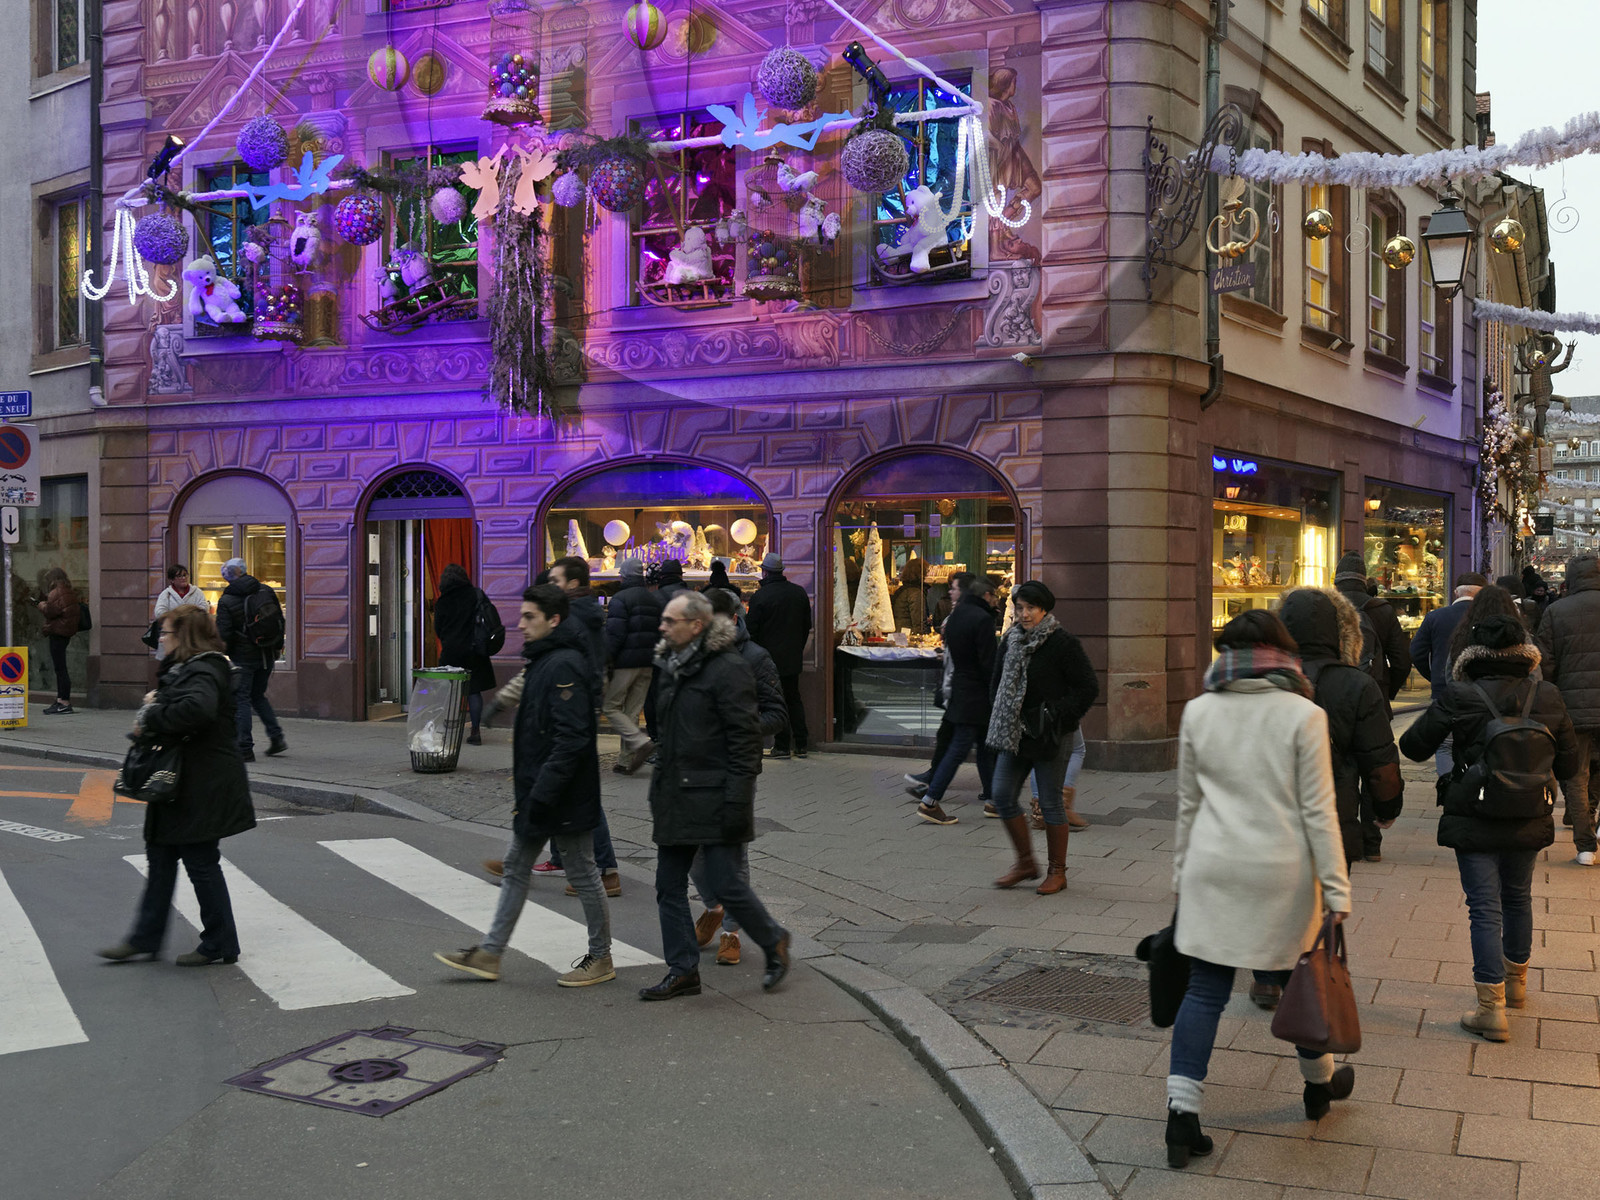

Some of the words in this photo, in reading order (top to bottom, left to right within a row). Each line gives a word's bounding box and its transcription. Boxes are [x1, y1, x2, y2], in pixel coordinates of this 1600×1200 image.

[1213, 265, 1252, 291] Christian
[7, 395, 19, 403] DU
[6, 405, 26, 413] NEUF
[624, 535, 690, 564] Christian
